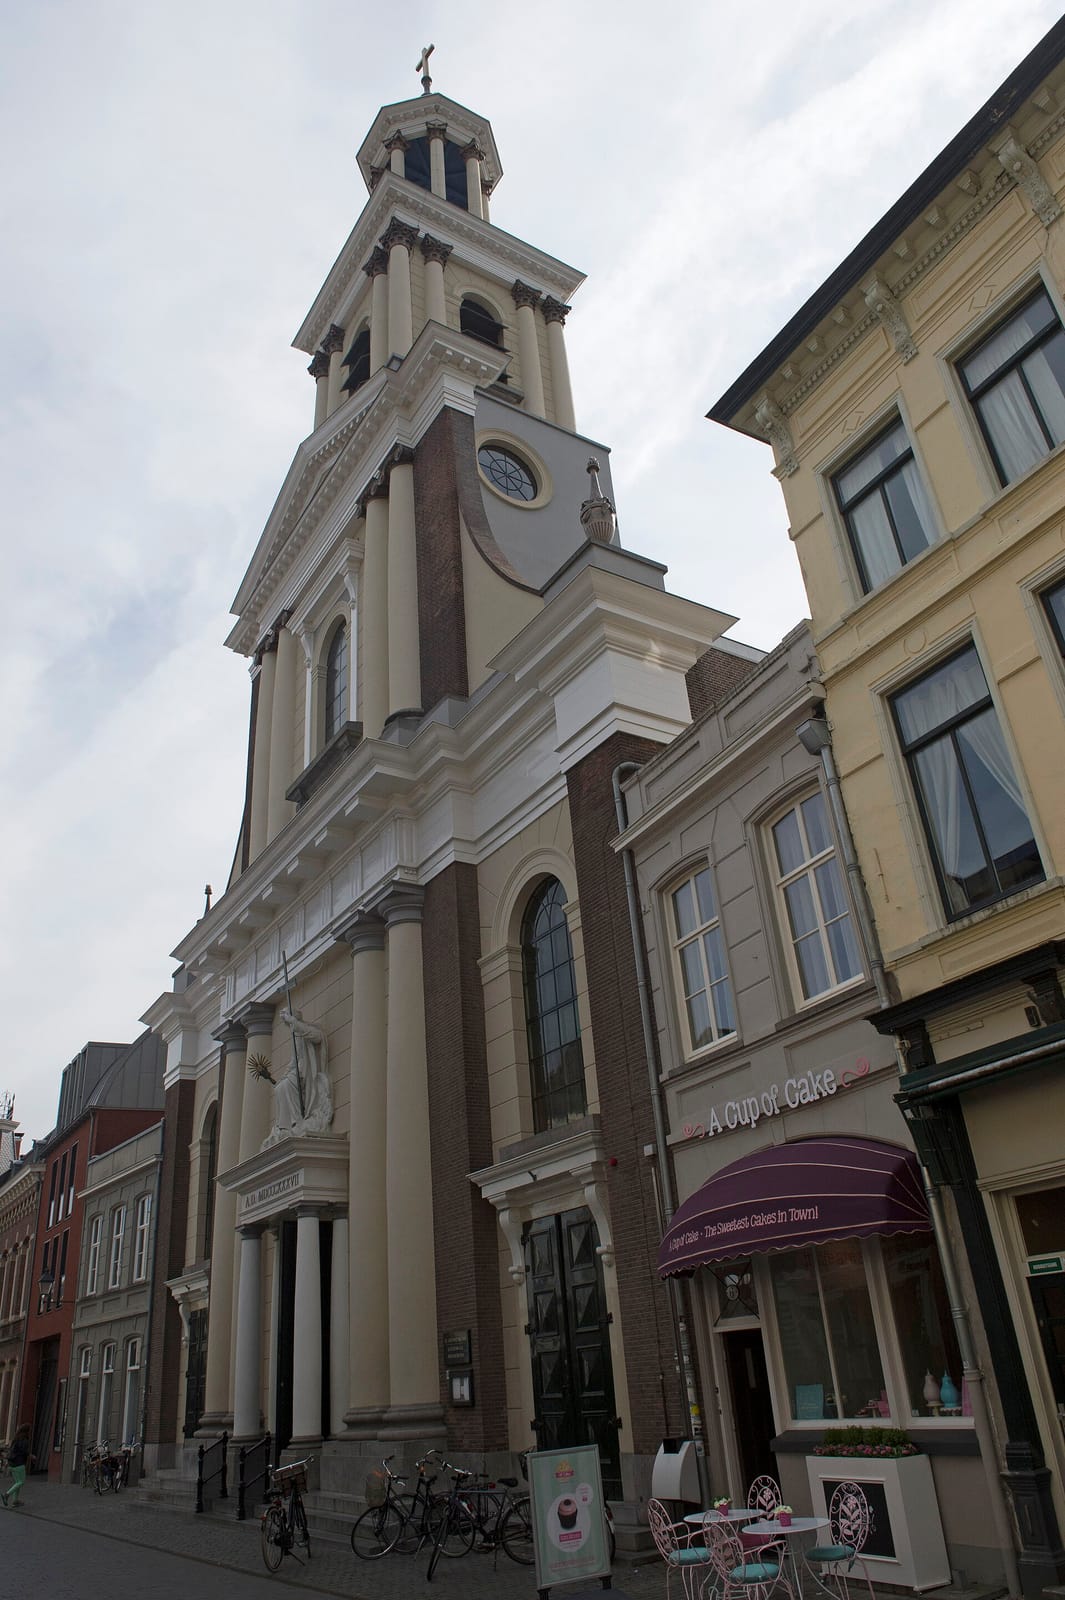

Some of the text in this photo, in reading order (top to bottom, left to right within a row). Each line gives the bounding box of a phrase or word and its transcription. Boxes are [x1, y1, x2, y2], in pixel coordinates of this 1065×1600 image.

[708, 1068, 837, 1136] A Cup of Cake
[685, 1230, 699, 1244] Cake
[704, 1225, 717, 1238] The
[717, 1216, 750, 1235] Sweetest
[750, 1212, 777, 1227] Cakes
[777, 1209, 787, 1223] in
[788, 1204, 819, 1222] Town!
